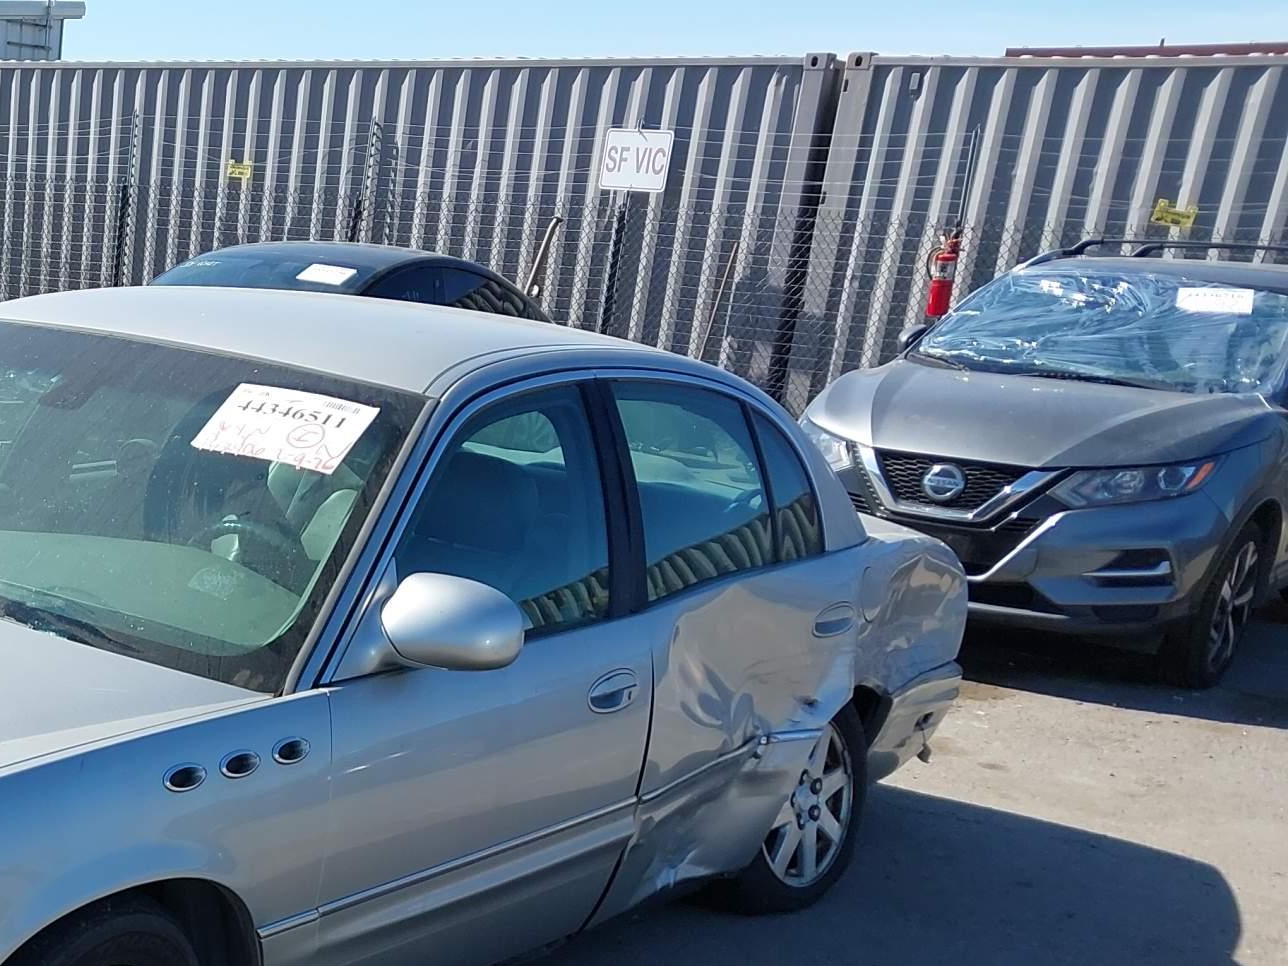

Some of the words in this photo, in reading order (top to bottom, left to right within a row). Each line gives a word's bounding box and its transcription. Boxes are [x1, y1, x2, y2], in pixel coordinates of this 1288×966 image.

[605, 145, 631, 173] SF
[635, 146, 667, 175] VIC
[237, 399, 348, 429] 44346511
